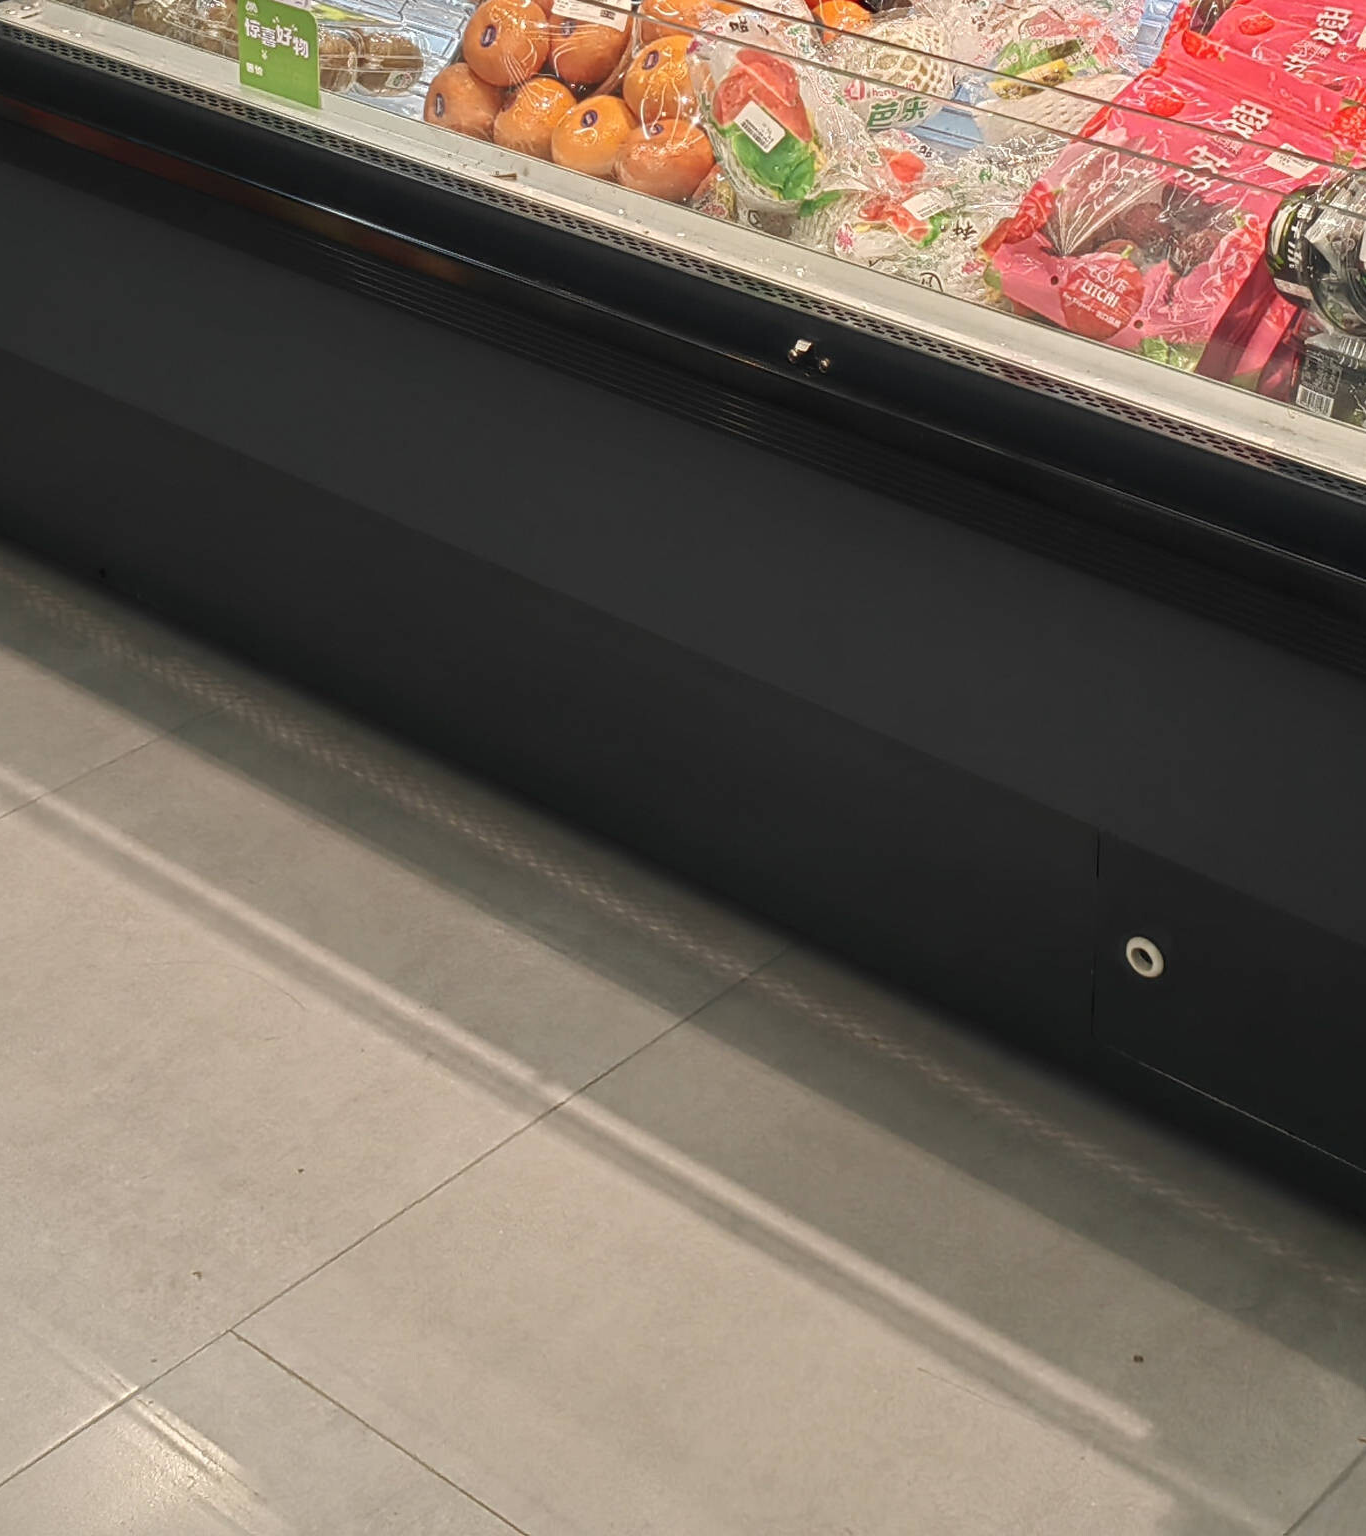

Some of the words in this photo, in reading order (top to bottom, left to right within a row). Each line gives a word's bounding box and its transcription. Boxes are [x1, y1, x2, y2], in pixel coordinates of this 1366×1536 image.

[244, 17, 310, 59] 惊喜好物
[866, 95, 930, 129] 芭乐
